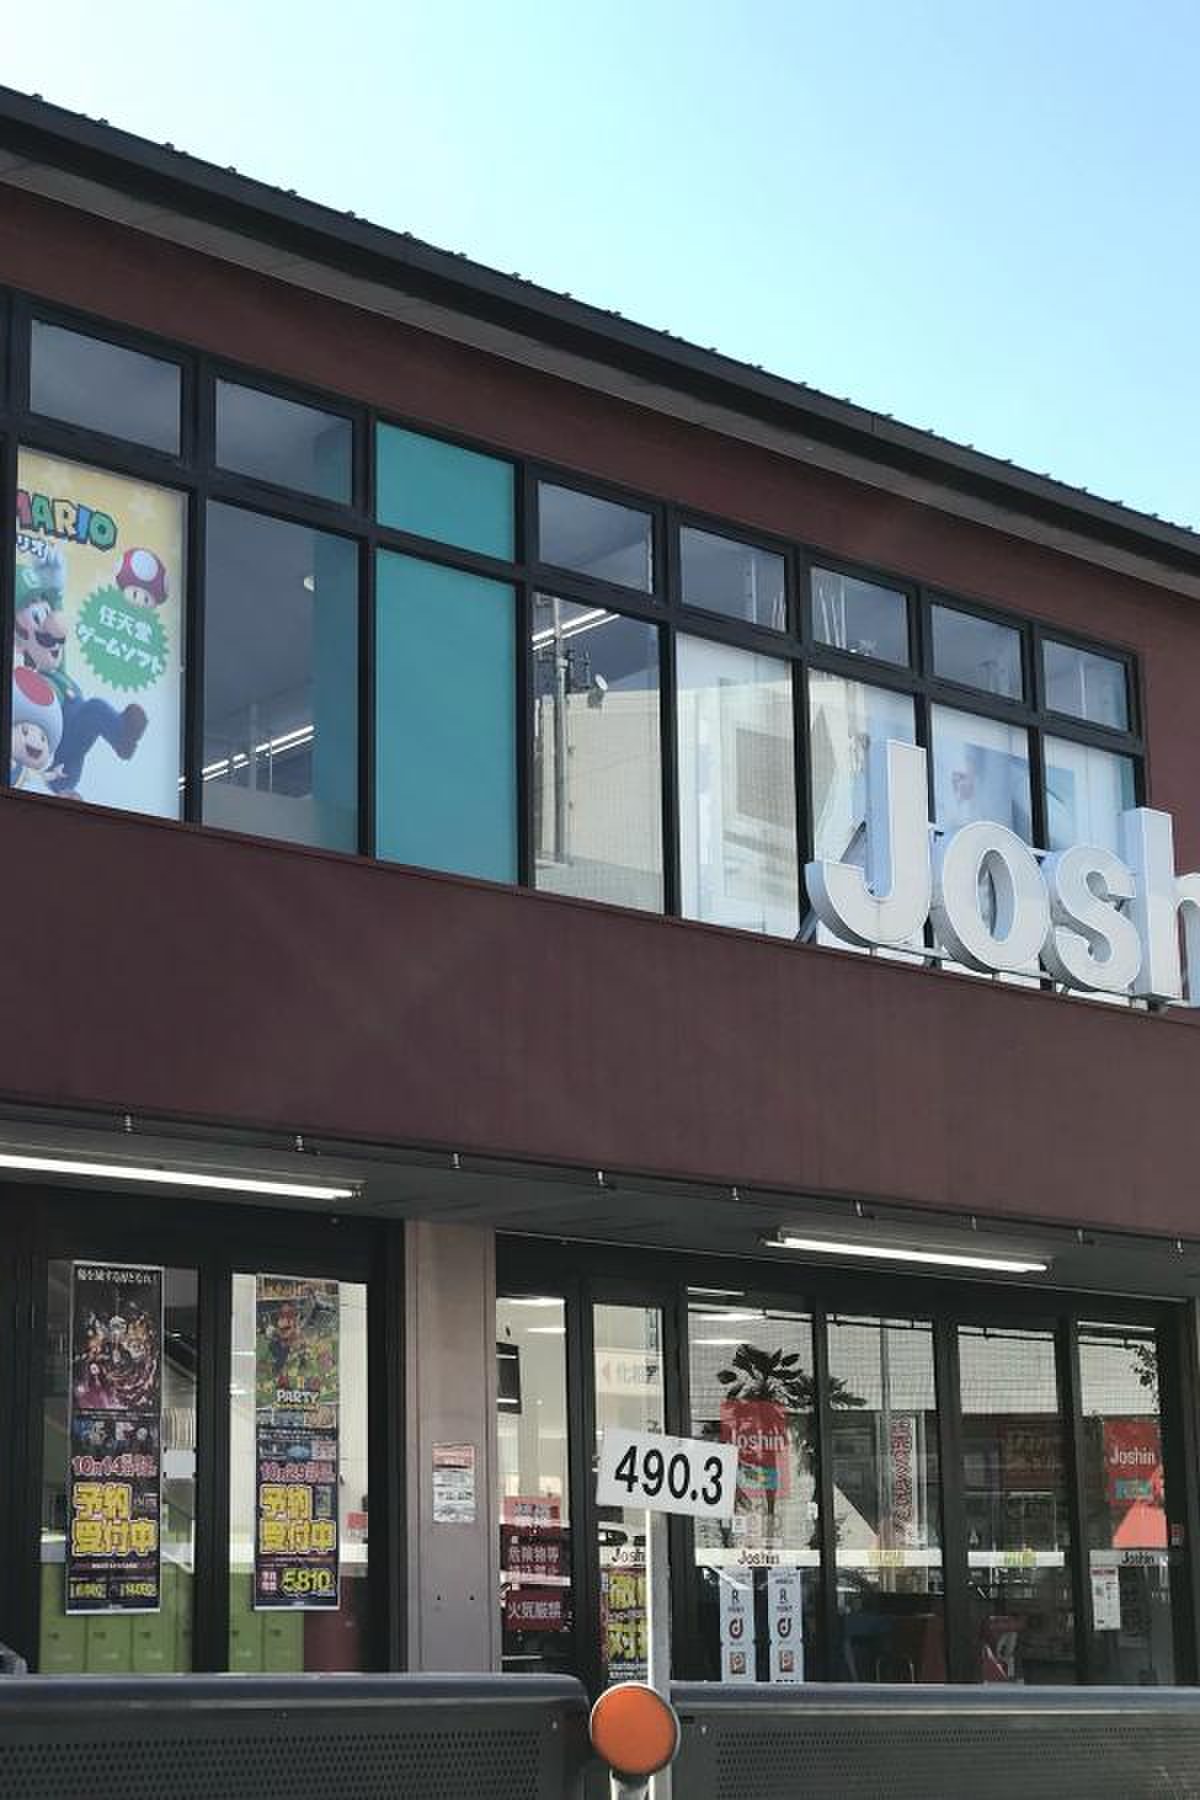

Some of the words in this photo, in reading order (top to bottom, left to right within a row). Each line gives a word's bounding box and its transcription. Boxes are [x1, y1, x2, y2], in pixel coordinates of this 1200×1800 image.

[99, 606, 153, 642] 任天堂
[76, 626, 163, 674] ゲームソフト
[276, 1389, 320, 1404] PARTY
[1109, 1446, 1156, 1467] Joshin
[614, 1445, 724, 1505] 490.3
[737, 1550, 780, 1566] Joshin
